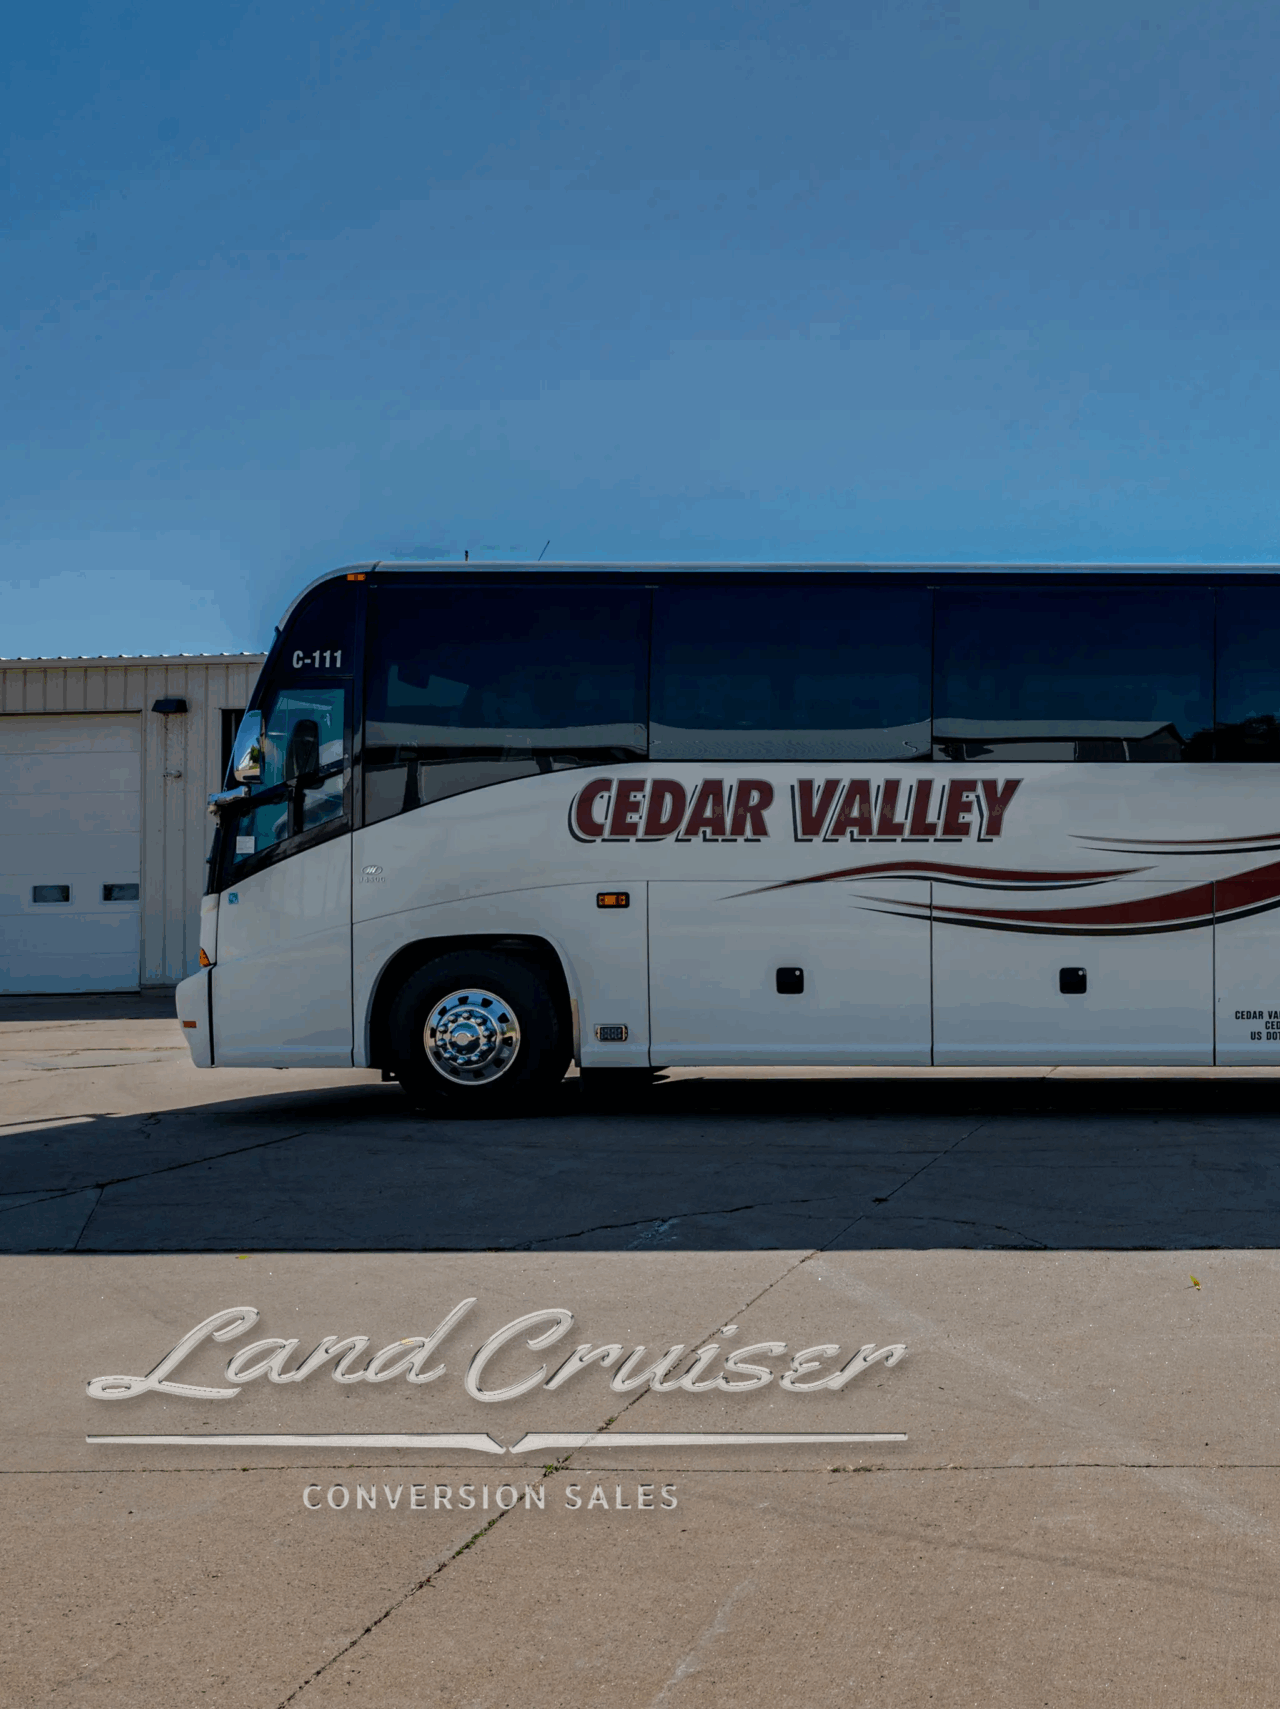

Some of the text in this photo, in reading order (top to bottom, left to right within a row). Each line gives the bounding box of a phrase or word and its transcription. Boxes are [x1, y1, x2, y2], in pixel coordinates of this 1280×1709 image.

[292, 650, 342, 669] C-111
[568, 777, 1024, 843] CEDAR VALLEY
[1234, 1010, 1264, 1020] CEDAR
[1250, 1031, 1262, 1041] US
